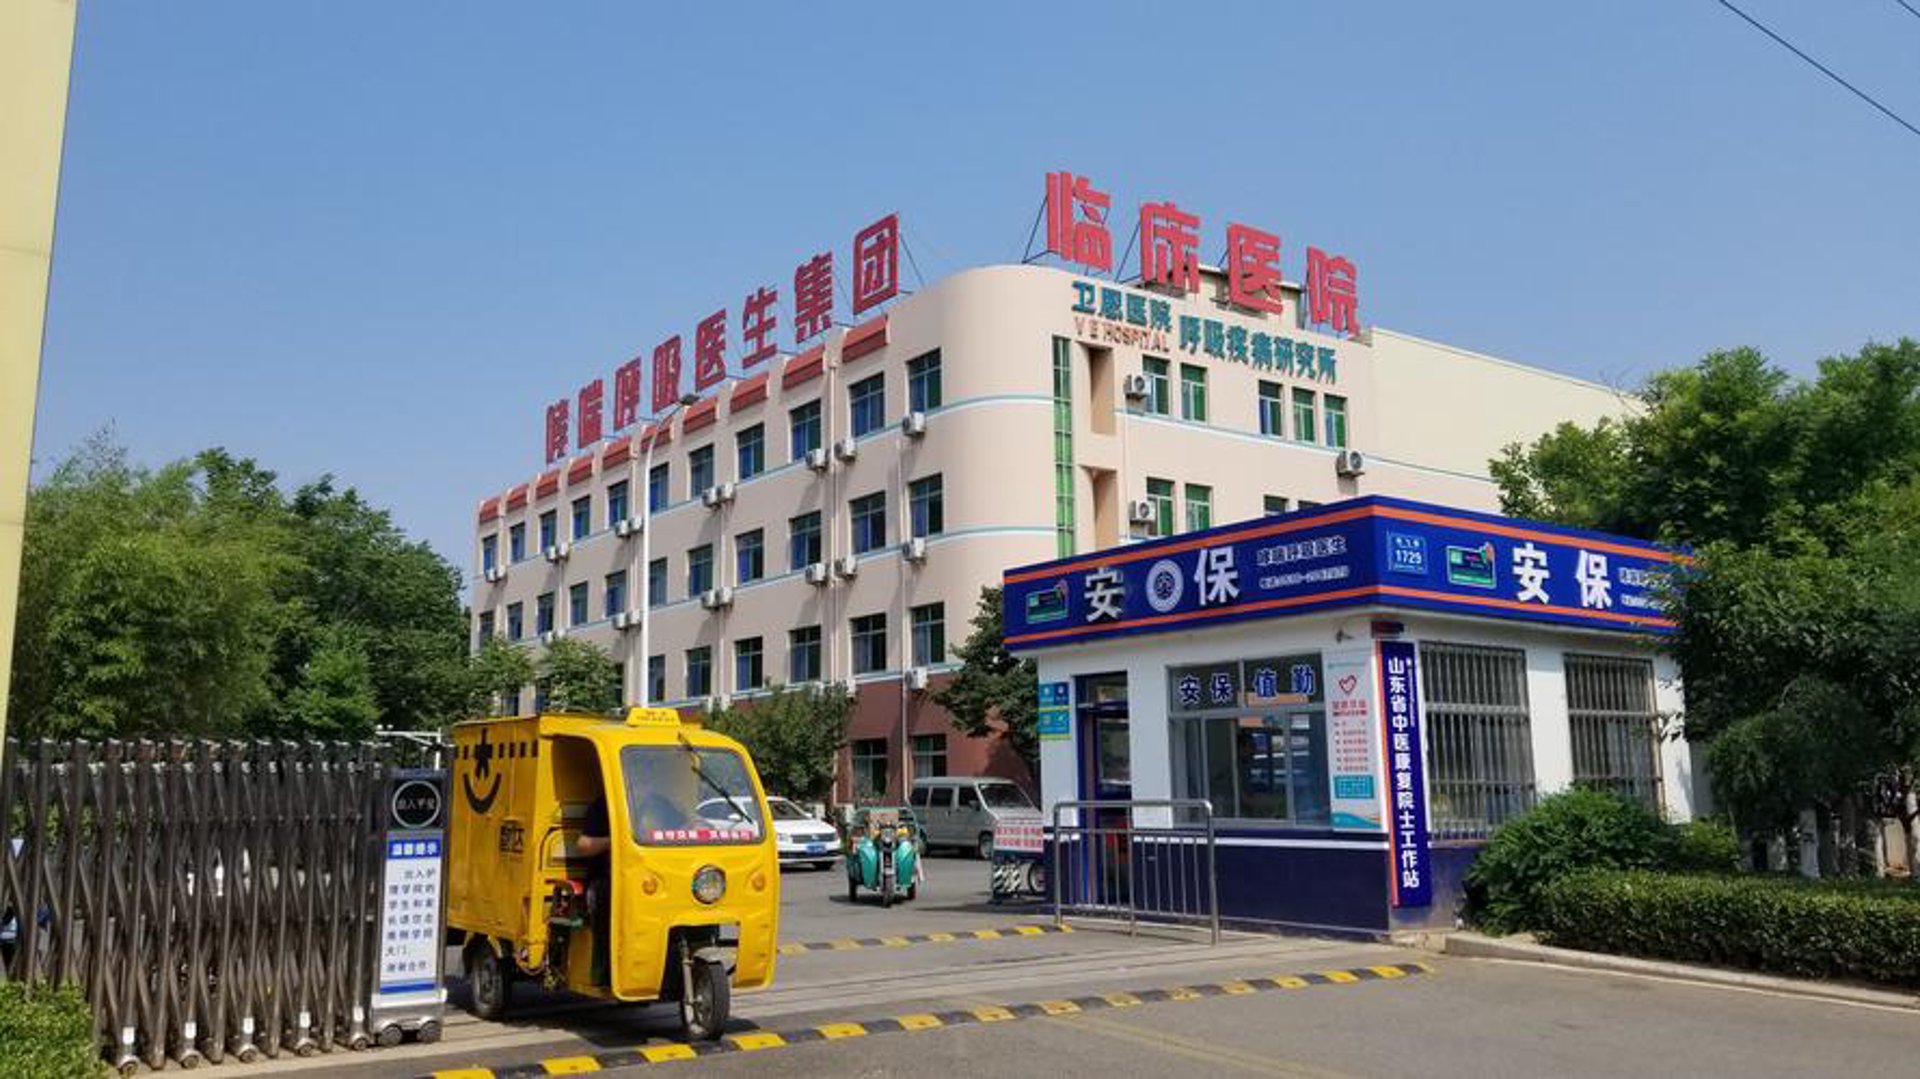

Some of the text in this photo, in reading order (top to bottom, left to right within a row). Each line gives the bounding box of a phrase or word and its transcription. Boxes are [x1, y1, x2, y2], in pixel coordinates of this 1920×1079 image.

[545, 211, 899, 464] 哮喘呼吸医生集团
[1045, 171, 1361, 337] 临床医院
[1178, 314, 1337, 385] 呼吸疾病研究所
[1387, 656, 1420, 888] 山东省中医康复院士工作站
